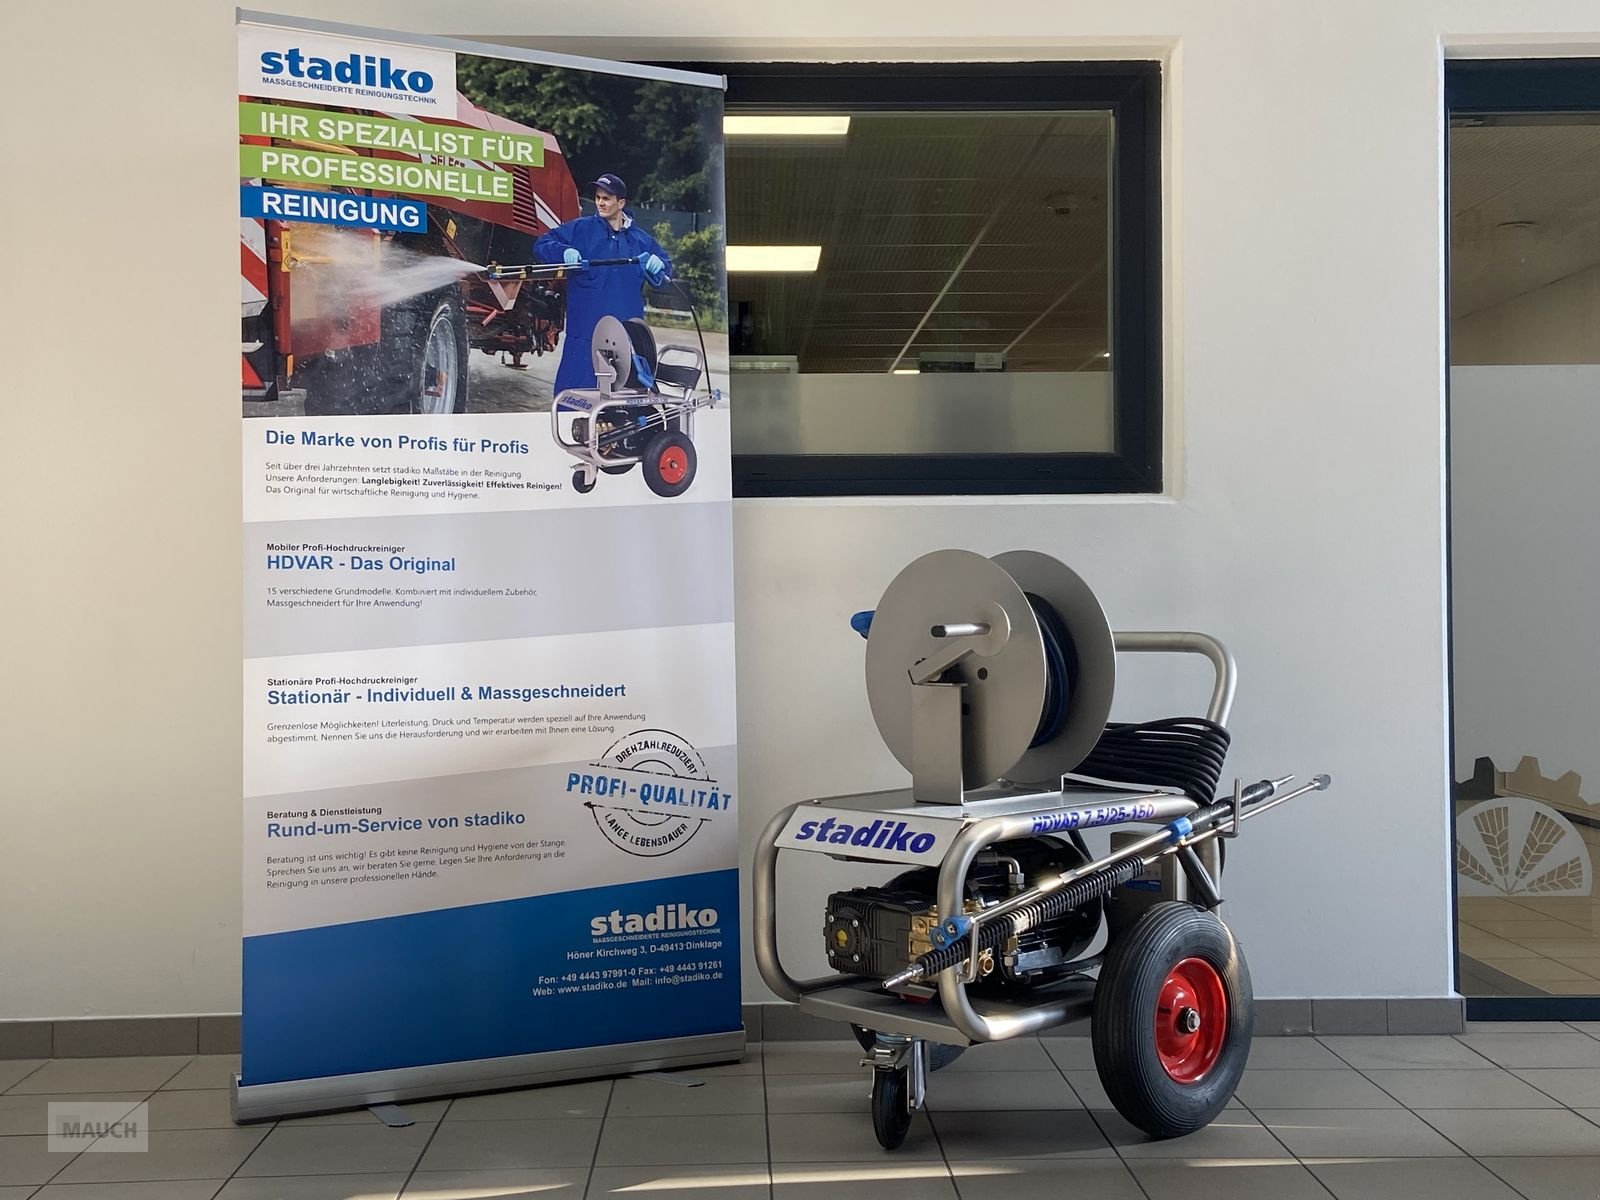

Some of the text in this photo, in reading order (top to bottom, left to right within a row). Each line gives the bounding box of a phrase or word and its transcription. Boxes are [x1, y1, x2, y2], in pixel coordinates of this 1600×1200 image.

[260, 47, 434, 93] stadiko
[262, 77, 437, 105] MASSGESCHNEIDERTE REINIGUNGSTECHNIK
[260, 111, 310, 138] IHR
[318, 118, 474, 156] SPEZIALIST
[482, 136, 534, 163] FÜR
[262, 151, 509, 197] PROFESSIONELLE
[262, 192, 420, 227] REINIGUNG
[563, 395, 593, 411] stadiko
[266, 430, 529, 454] Die Marke von Profis für Profis
[266, 462, 281, 470] Seit
[283, 463, 302, 471] über
[304, 463, 321, 471] drei
[322, 464, 370, 473] Jahrzehnten
[470, 469, 482, 477] der
[266, 486, 281, 494] Das
[283, 486, 316, 496] Original
[318, 487, 329, 495] für
[332, 487, 389, 496] wirtschaftliche
[391, 489, 429, 499] Reinigung
[431, 490, 445, 498] und
[361, 477, 420, 487] Langlebigkeit!
[423, 479, 484, 490] Zuverlässigkeit!
[527, 482, 562, 491] Reinigen!
[266, 543, 405, 554] Mobiler Profi-Hochdruckreiniger
[267, 555, 333, 570] HDVAR
[351, 556, 384, 570] Das
[389, 557, 455, 574] Original
[334, 588, 393, 596] Grundmodelle.
[395, 588, 437, 596] Kombiniert
[453, 588, 503, 596] individuellem
[266, 599, 340, 608] Massgeschneidert
[342, 599, 354, 607] für
[373, 600, 423, 609] Anwendung!
[267, 677, 418, 686] Stationäre Profi-Hochdruckreiniger
[268, 689, 351, 704] Stationär
[367, 687, 455, 702] Individuell
[461, 687, 473, 700] &
[478, 684, 626, 702] Massgeschneidert
[267, 722, 318, 731] Grenzenlose
[320, 720, 379, 730] Möglichkeiten!
[432, 718, 454, 726] Druck
[473, 717, 515, 726] Temperatur
[517, 716, 544, 724] werden
[546, 714, 573, 724] speziell
[574, 714, 586, 722] auf
[587, 714, 602, 722] Ihre
[603, 713, 646, 722] Anwendung
[321, 733, 352, 741] Nennen
[400, 729, 463, 739] Herausforderung
[465, 728, 480, 736] und
[482, 727, 494, 735] wir
[495, 727, 534, 735] erarbeiten
[549, 726, 569, 734] Ihnen
[615, 740, 698, 775] DREHZAHLREDUZIERT
[566, 773, 732, 811] PROFI-QUALITÄT
[267, 810, 308, 819] Beratung
[320, 807, 382, 817] Dienstleistung
[1031, 804, 1155, 833] HDVAR 7.5/25-150
[268, 811, 526, 838] Rund-um-Service von stadiko
[604, 813, 688, 848] LANGE LEBENSDAUER
[795, 817, 936, 853] stadiko
[267, 855, 305, 864] Beratung
[335, 852, 367, 860] wichtig!
[380, 849, 396, 859] gibt
[420, 846, 458, 856] Reinigung
[477, 843, 508, 852] Hygiene
[267, 868, 305, 877] Sprechen
[308, 866, 320, 874] Sie
[367, 862, 397, 870] beraten
[439, 858, 462, 867] Legen
[464, 856, 476, 864] Sie
[477, 855, 492, 863] Ihre
[494, 852, 541, 862] Anforderung
[554, 850, 565, 858] die
[267, 879, 309, 889] Reinigung
[310, 878, 318, 886] in
[320, 877, 348, 885] unsere
[350, 872, 410, 884] professionellen
[590, 903, 718, 935] stadiko
[592, 928, 721, 943] MASSGESCHNEIDERTE REINIGUNGSTECHNIK
[567, 940, 722, 960] Höner Kirchweg 3, D-49413 Dinklage
[538, 960, 722, 985] Fon: +49 4443 97991-0 Fax: +49 4443 91261
[533, 971, 723, 996] Web: www.stadiko.de Mail: info@stadiko.de
